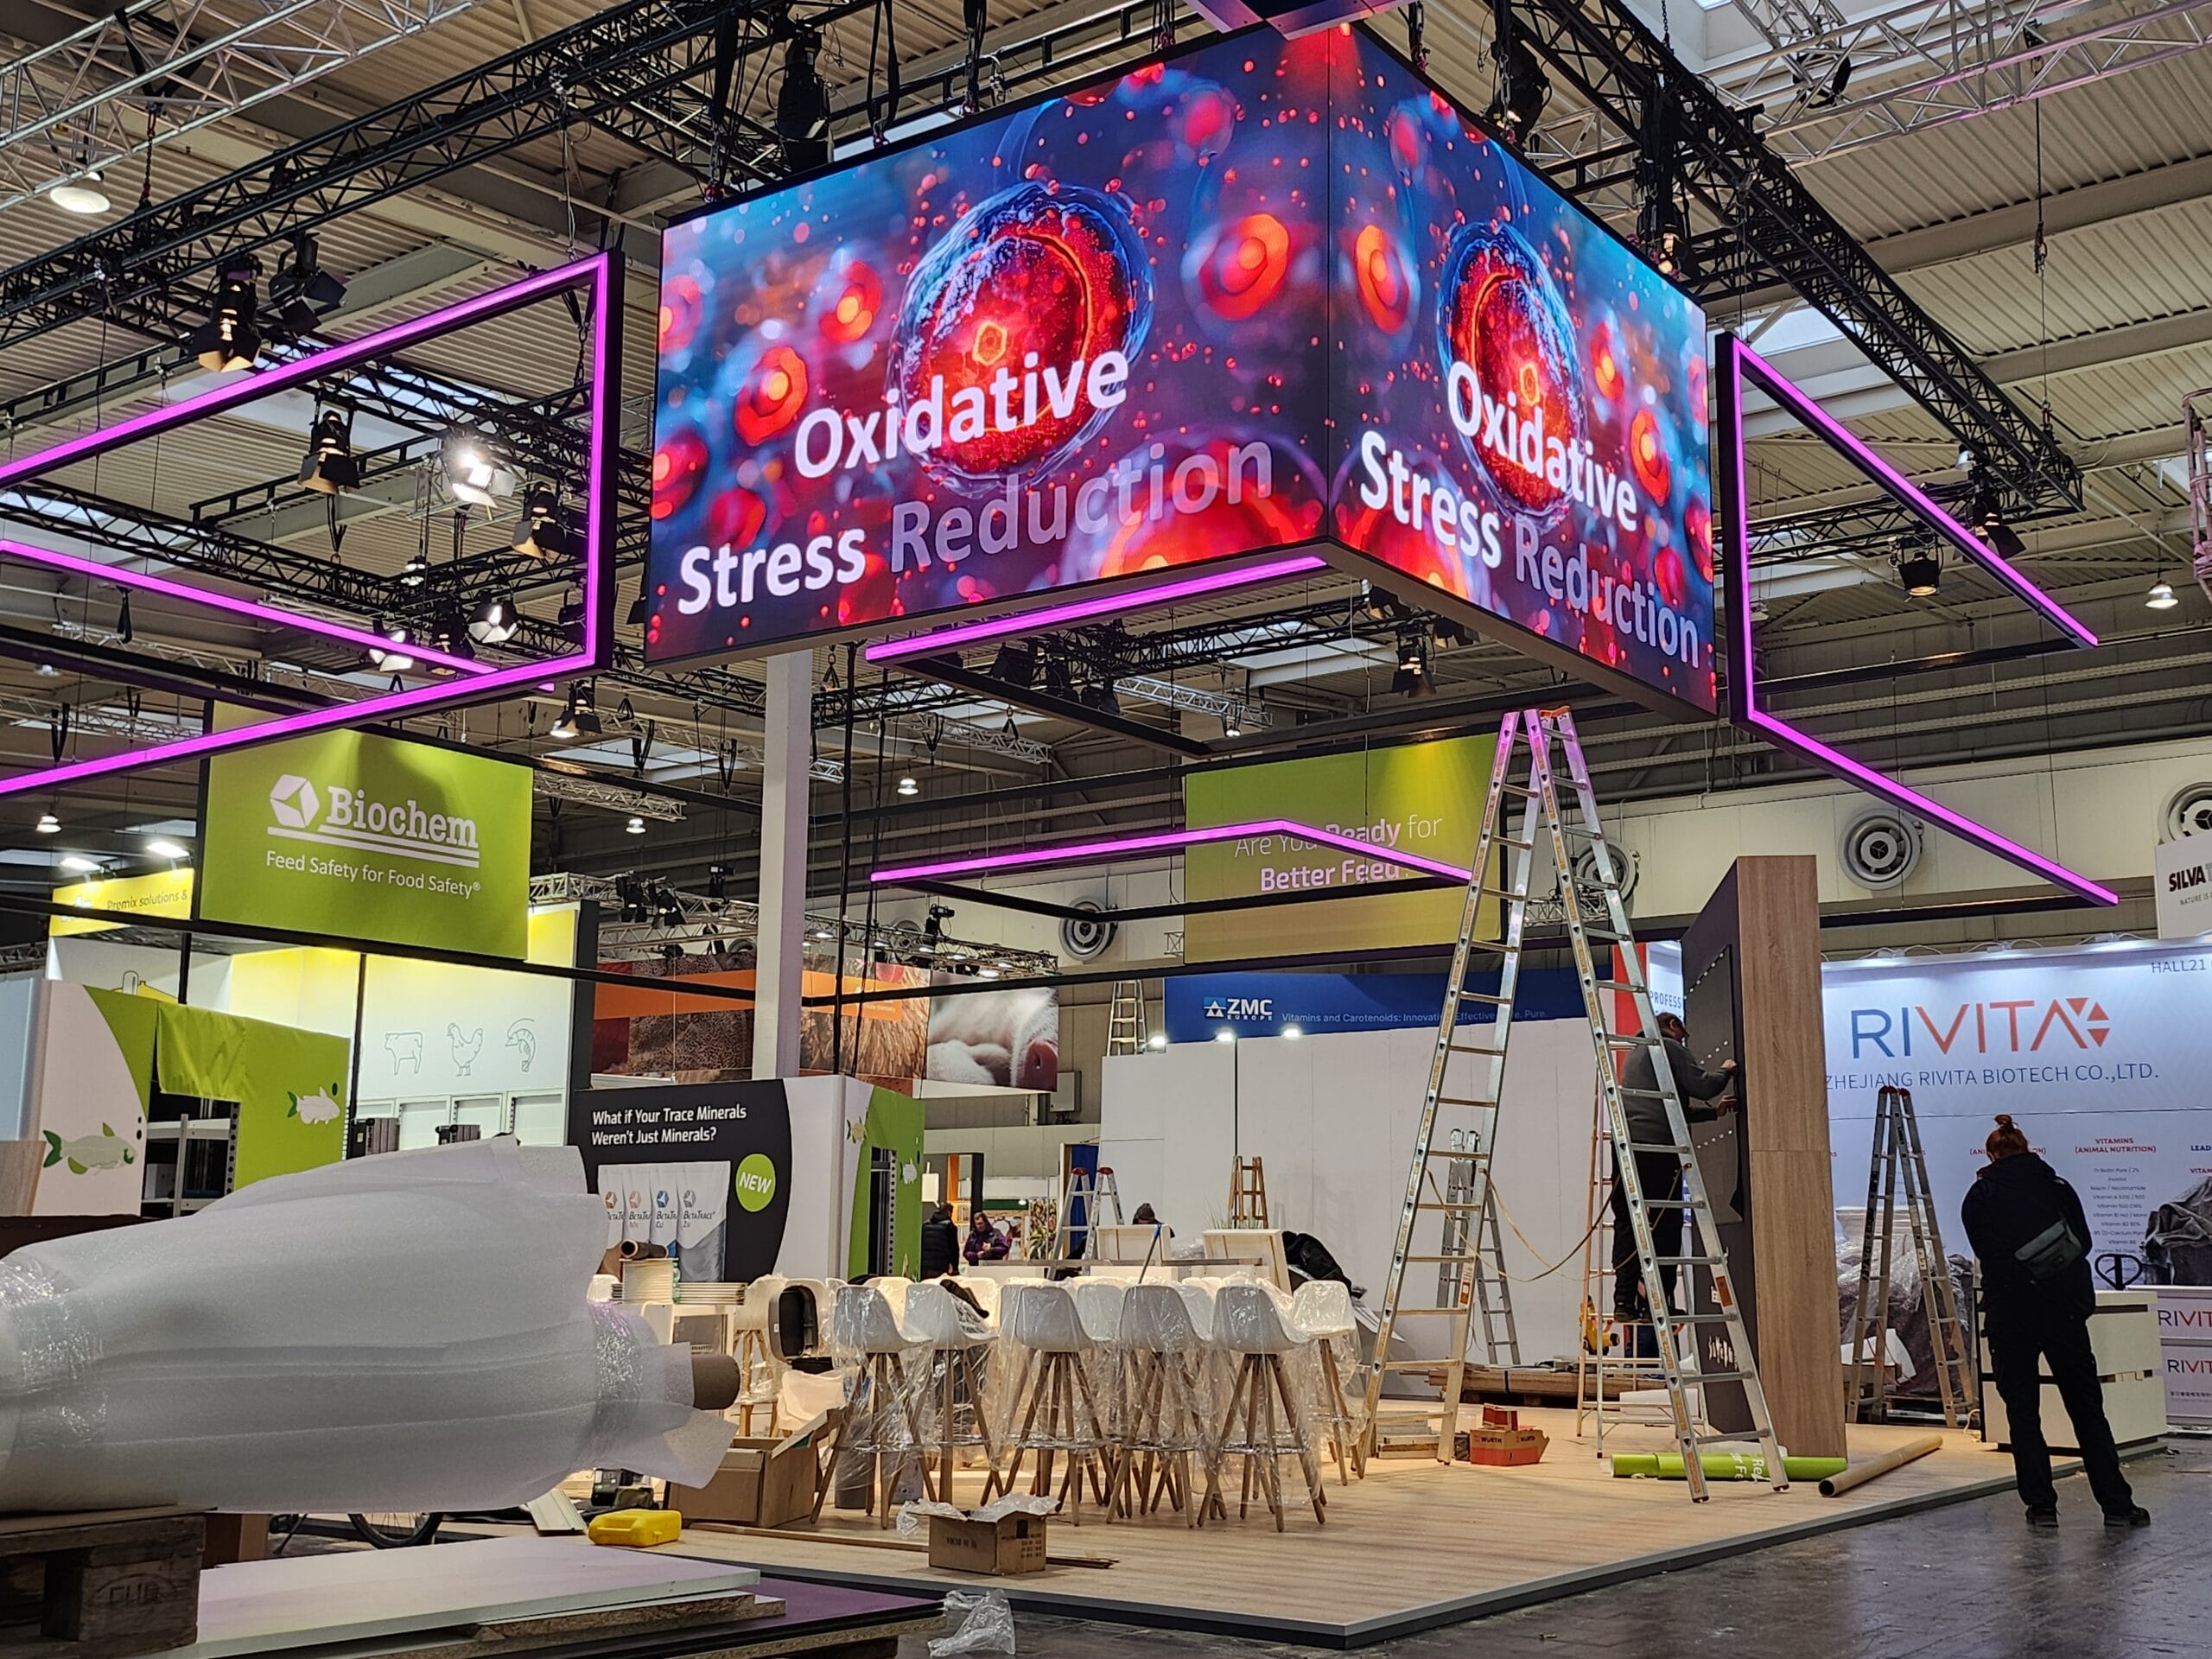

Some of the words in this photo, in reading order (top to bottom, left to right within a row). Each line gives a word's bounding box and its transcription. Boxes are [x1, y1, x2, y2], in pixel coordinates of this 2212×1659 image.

[795, 349, 1128, 478] Oxidative
[1448, 360, 1637, 532] Oxidative
[677, 527, 865, 615] Stress
[892, 439, 1273, 573] Reduction
[1360, 430, 1502, 569] Stress
[1516, 512, 1700, 669] Reduction
[326, 786, 479, 848] Biochem
[1408, 814, 1443, 839] for
[266, 850, 305, 871] Feed
[309, 857, 359, 882] Safety
[362, 865, 384, 882] for
[389, 869, 424, 889] Food
[1261, 865, 1336, 892] Better
[107, 897, 137, 911] Premix
[139, 892, 179, 906] solutions
[181, 889, 188, 899] &
[2180, 893, 2202, 906] NATURE
[2152, 959, 2206, 973] HALL21
[1227, 998, 1273, 1016] ZMC
[1281, 1013, 1321, 1023] Vitamins
[1323, 1013, 1340, 1022] and
[1343, 1012, 1402, 1022] Carotenoids:
[1403, 1013, 1442, 1023] Innovati
[1851, 998, 2088, 1059] RIVITA
[1826, 1071, 1913, 1090] ZHEJIANG
[1919, 1069, 1977, 1087] RIVITA
[1984, 1065, 2068, 1084] BIOTECH
[2075, 1063, 2158, 1084] CO.,LTD.
[593, 1110, 621, 1125] What
[624, 1109, 632, 1124] if
[635, 1109, 661, 1123] Your
[663, 1107, 694, 1122] Trace
[696, 1103, 747, 1121] Minerals
[592, 1130, 633, 1146] Weren't
[636, 1129, 658, 1144] Just
[661, 1127, 717, 1143] Minerals?
[2075, 1146, 2108, 1154] (ANIMAL
[2110, 1145, 2157, 1154] NUTRITION)
[739, 1172, 772, 1194] NEW
